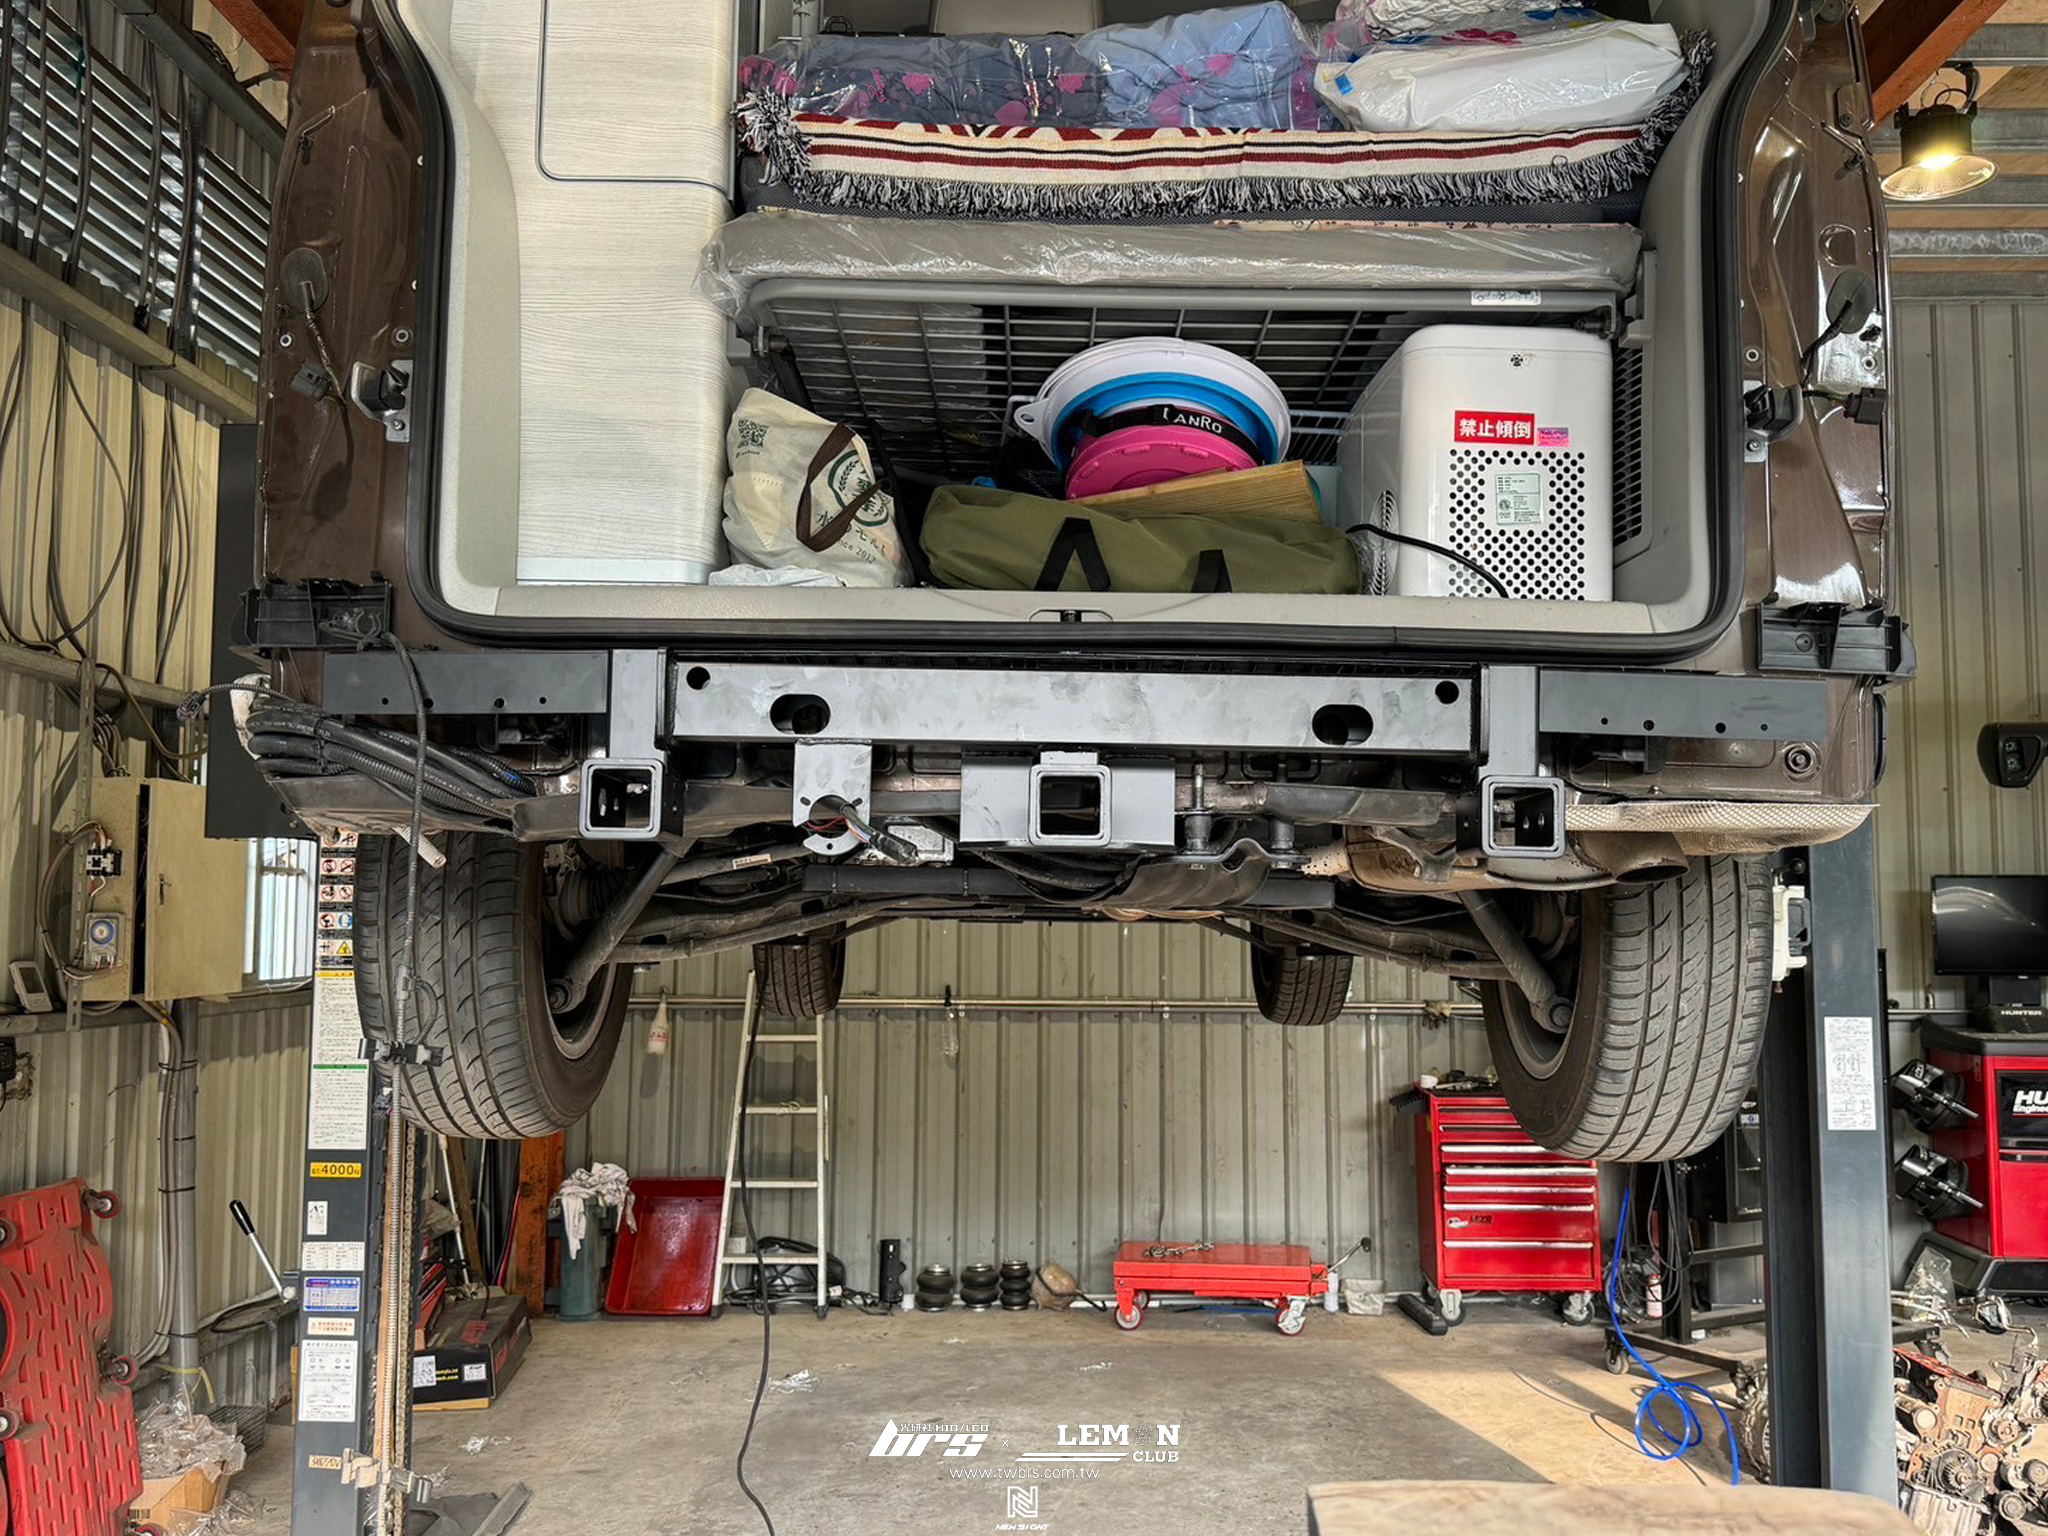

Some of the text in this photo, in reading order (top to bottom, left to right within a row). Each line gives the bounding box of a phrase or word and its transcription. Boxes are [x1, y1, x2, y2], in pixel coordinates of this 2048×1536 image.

[1460, 418, 1531, 439] 禁止傾倒
[856, 547, 877, 564] 2012
